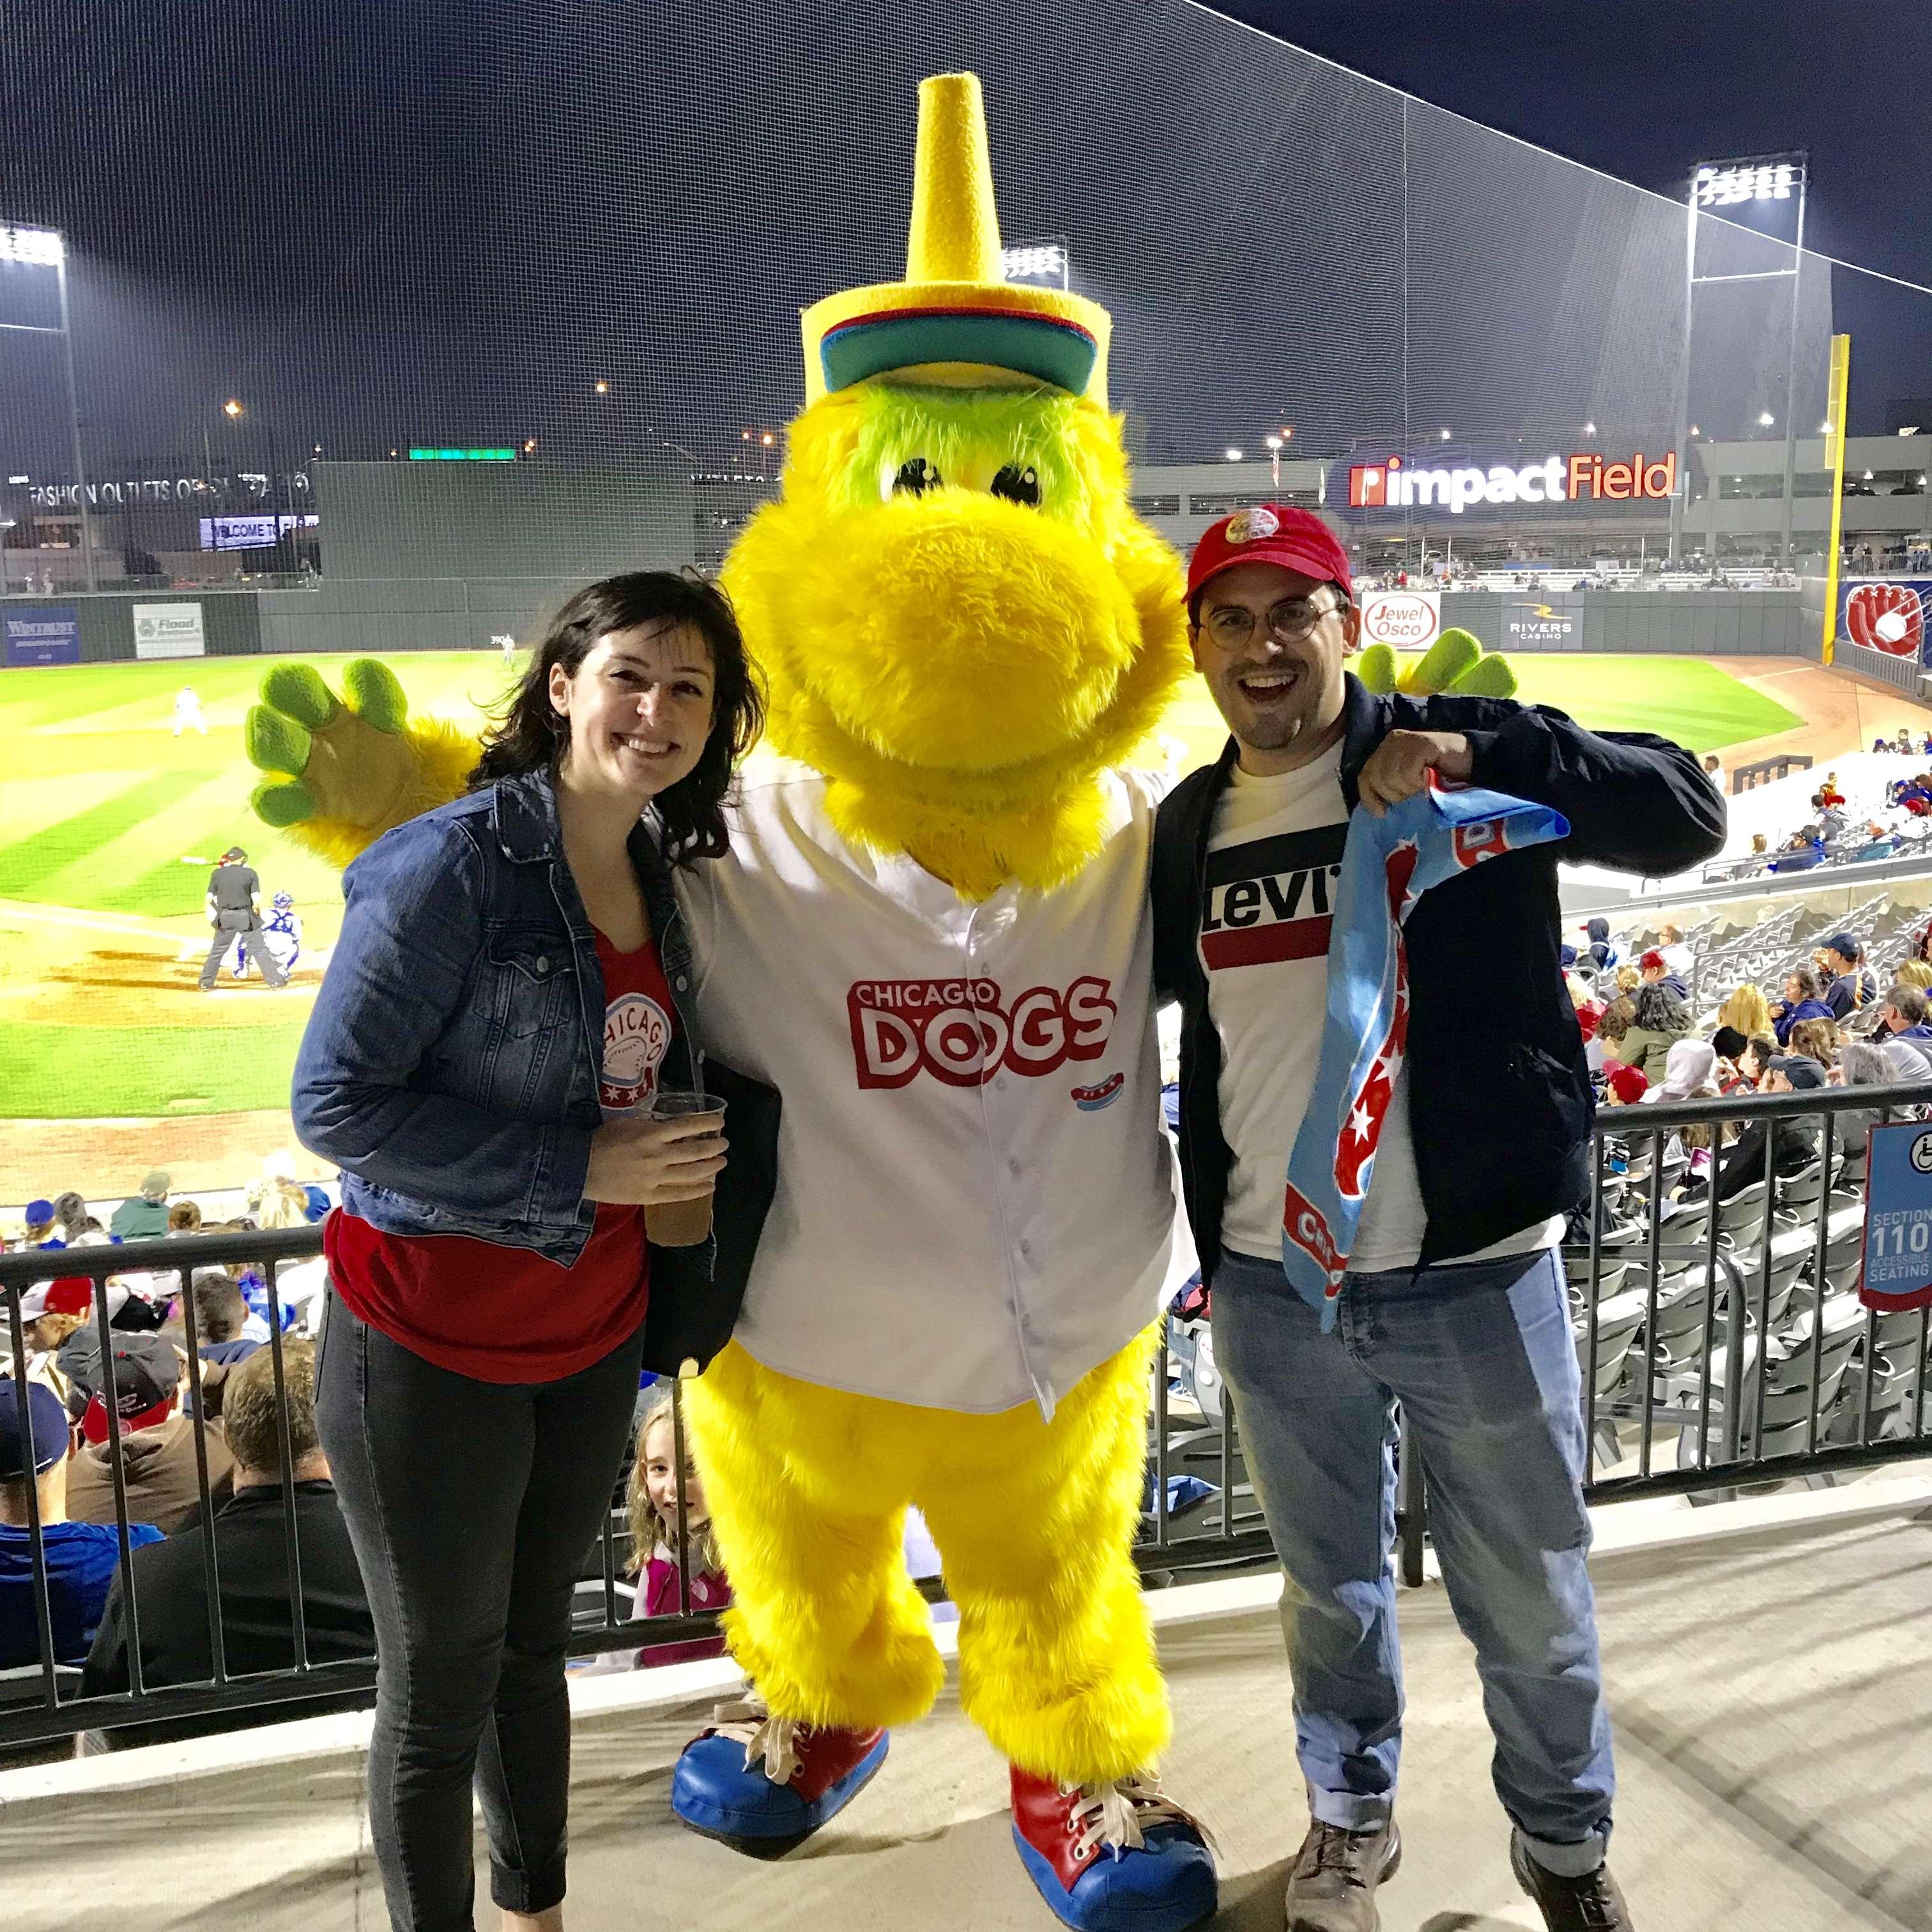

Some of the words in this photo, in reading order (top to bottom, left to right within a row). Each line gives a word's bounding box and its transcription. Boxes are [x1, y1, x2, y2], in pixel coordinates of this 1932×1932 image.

[1374, 605, 1424, 620] Jewel
[158, 619, 194, 629] Flood
[1377, 622, 1422, 636] Osco
[1510, 623, 1572, 633] RIVERS
[857, 978, 1116, 1081] DOGS
[1873, 1209, 1932, 1227] SECTION
[1872, 1222, 1929, 1257] 110
[1870, 1252, 1930, 1269] ACCESSIBLE
[1869, 1264, 1929, 1283] SEATING
